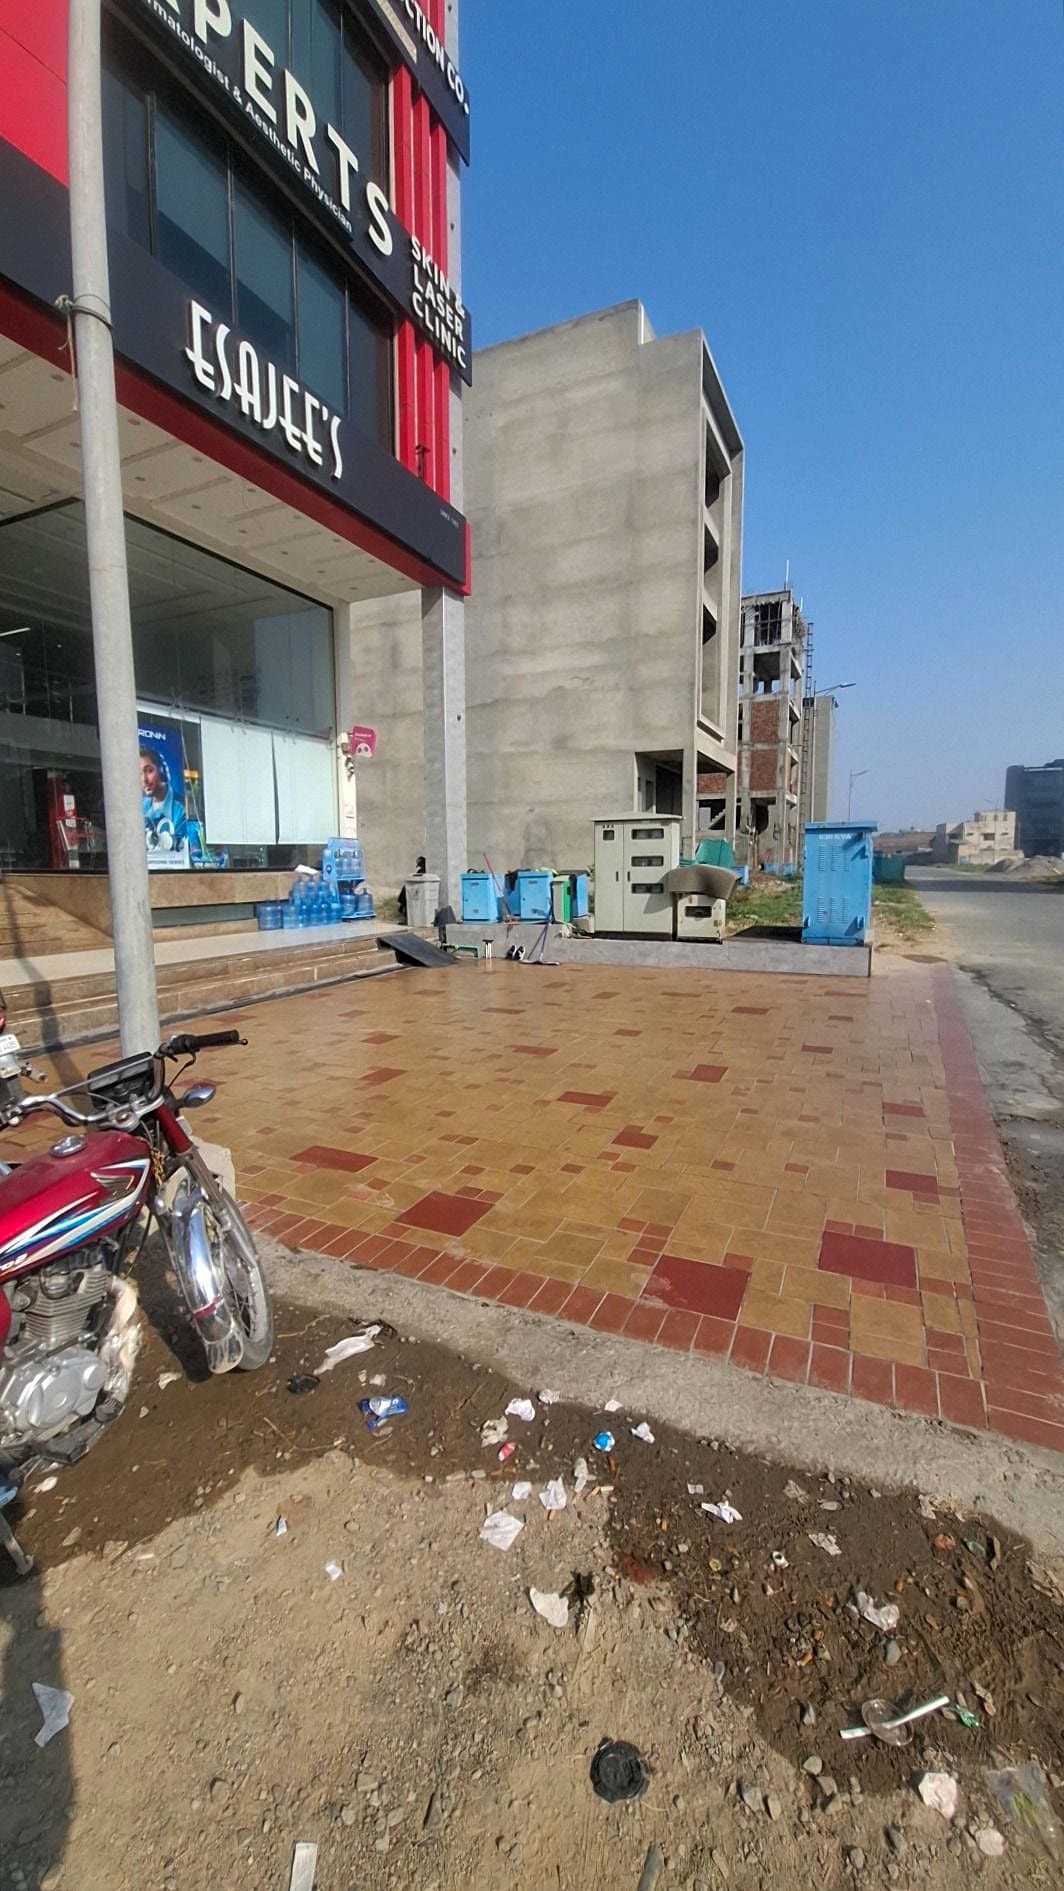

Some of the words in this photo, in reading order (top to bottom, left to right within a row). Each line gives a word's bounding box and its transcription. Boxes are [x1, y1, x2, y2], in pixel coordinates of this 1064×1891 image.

[447, 61, 469, 115] CO.
[164, 0, 393, 257] PERTS
[233, 86, 243, 105] &
[245, 102, 302, 172] Aesthetic
[303, 166, 352, 233] Physician
[411, 234, 450, 300] SKIN
[413, 263, 464, 342] LASER
[412, 291, 467, 369] CLINIC
[184, 299, 342, 480] ESAJEE'S
